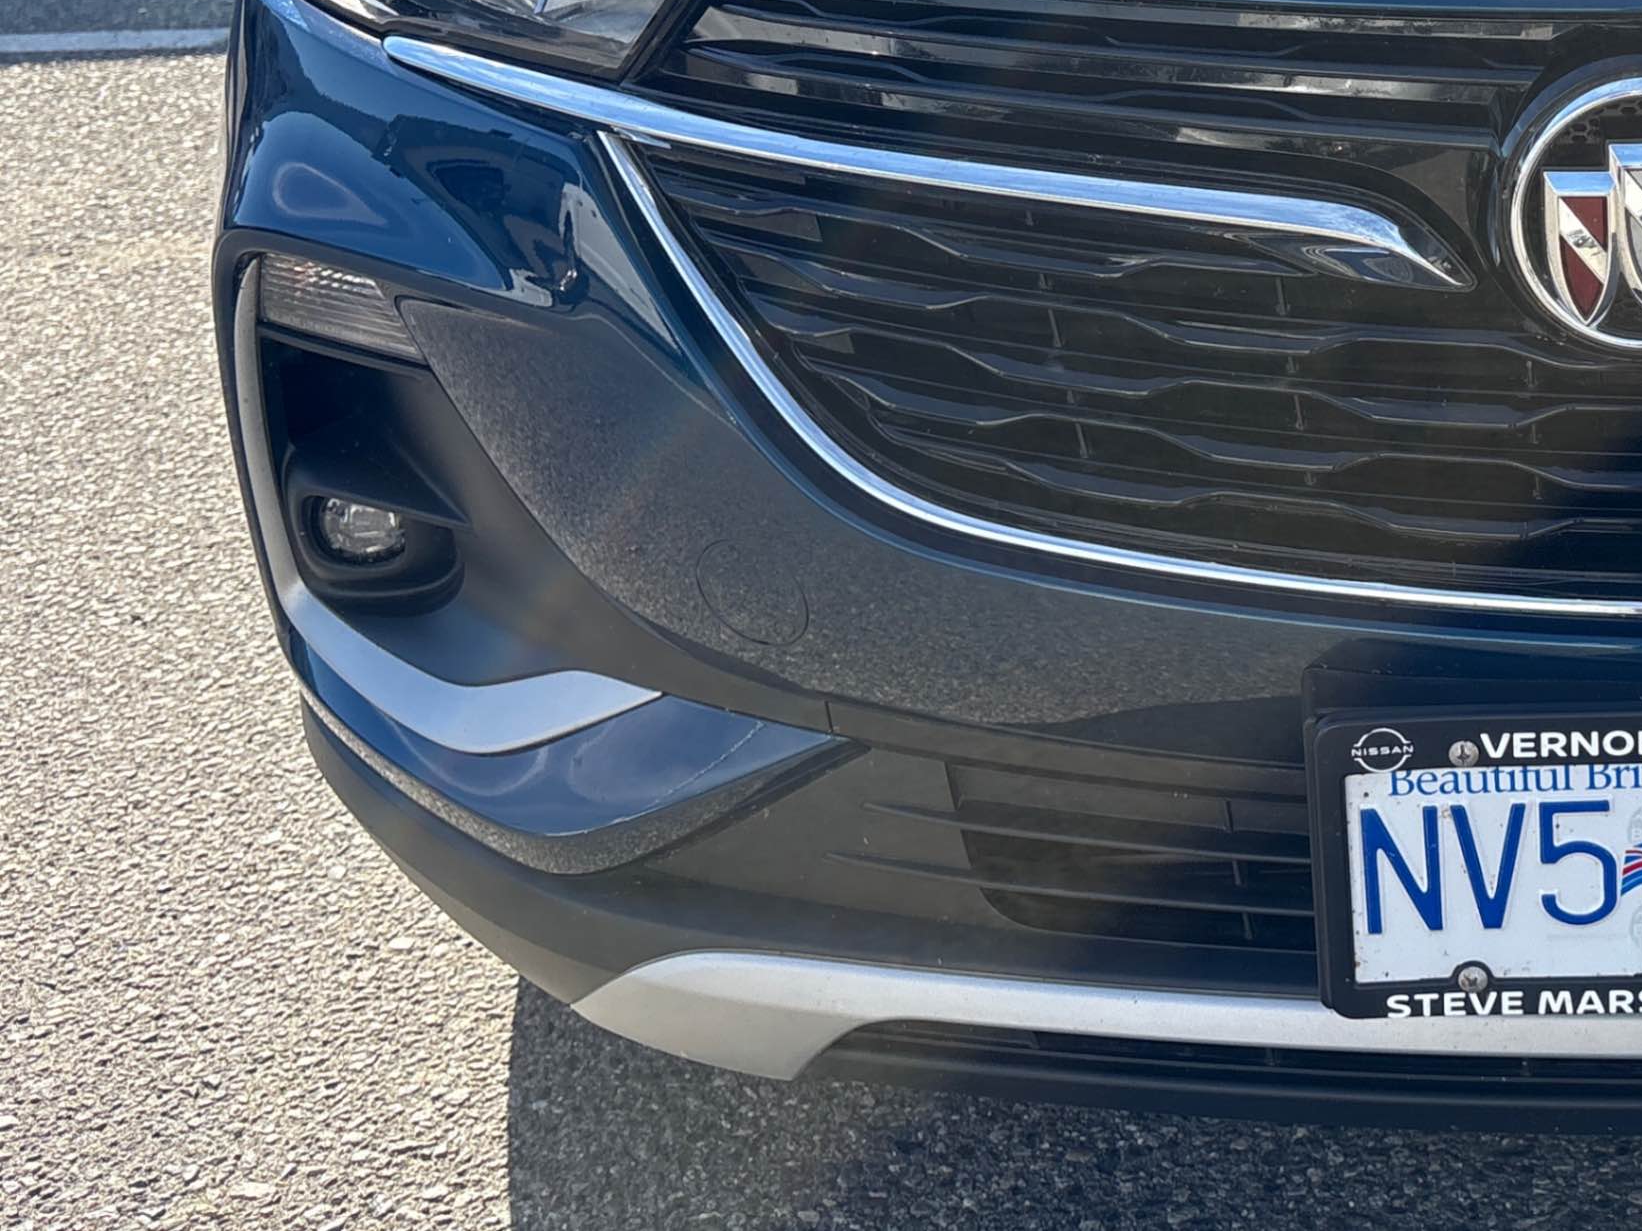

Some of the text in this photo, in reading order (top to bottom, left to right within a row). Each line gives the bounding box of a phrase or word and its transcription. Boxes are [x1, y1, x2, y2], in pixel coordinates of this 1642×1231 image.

[1351, 744, 1414, 757] NISSAN
[1388, 765, 1574, 797] Beautiful
[1359, 799, 1618, 935] NV5
[1386, 989, 1524, 1019] STEVE
